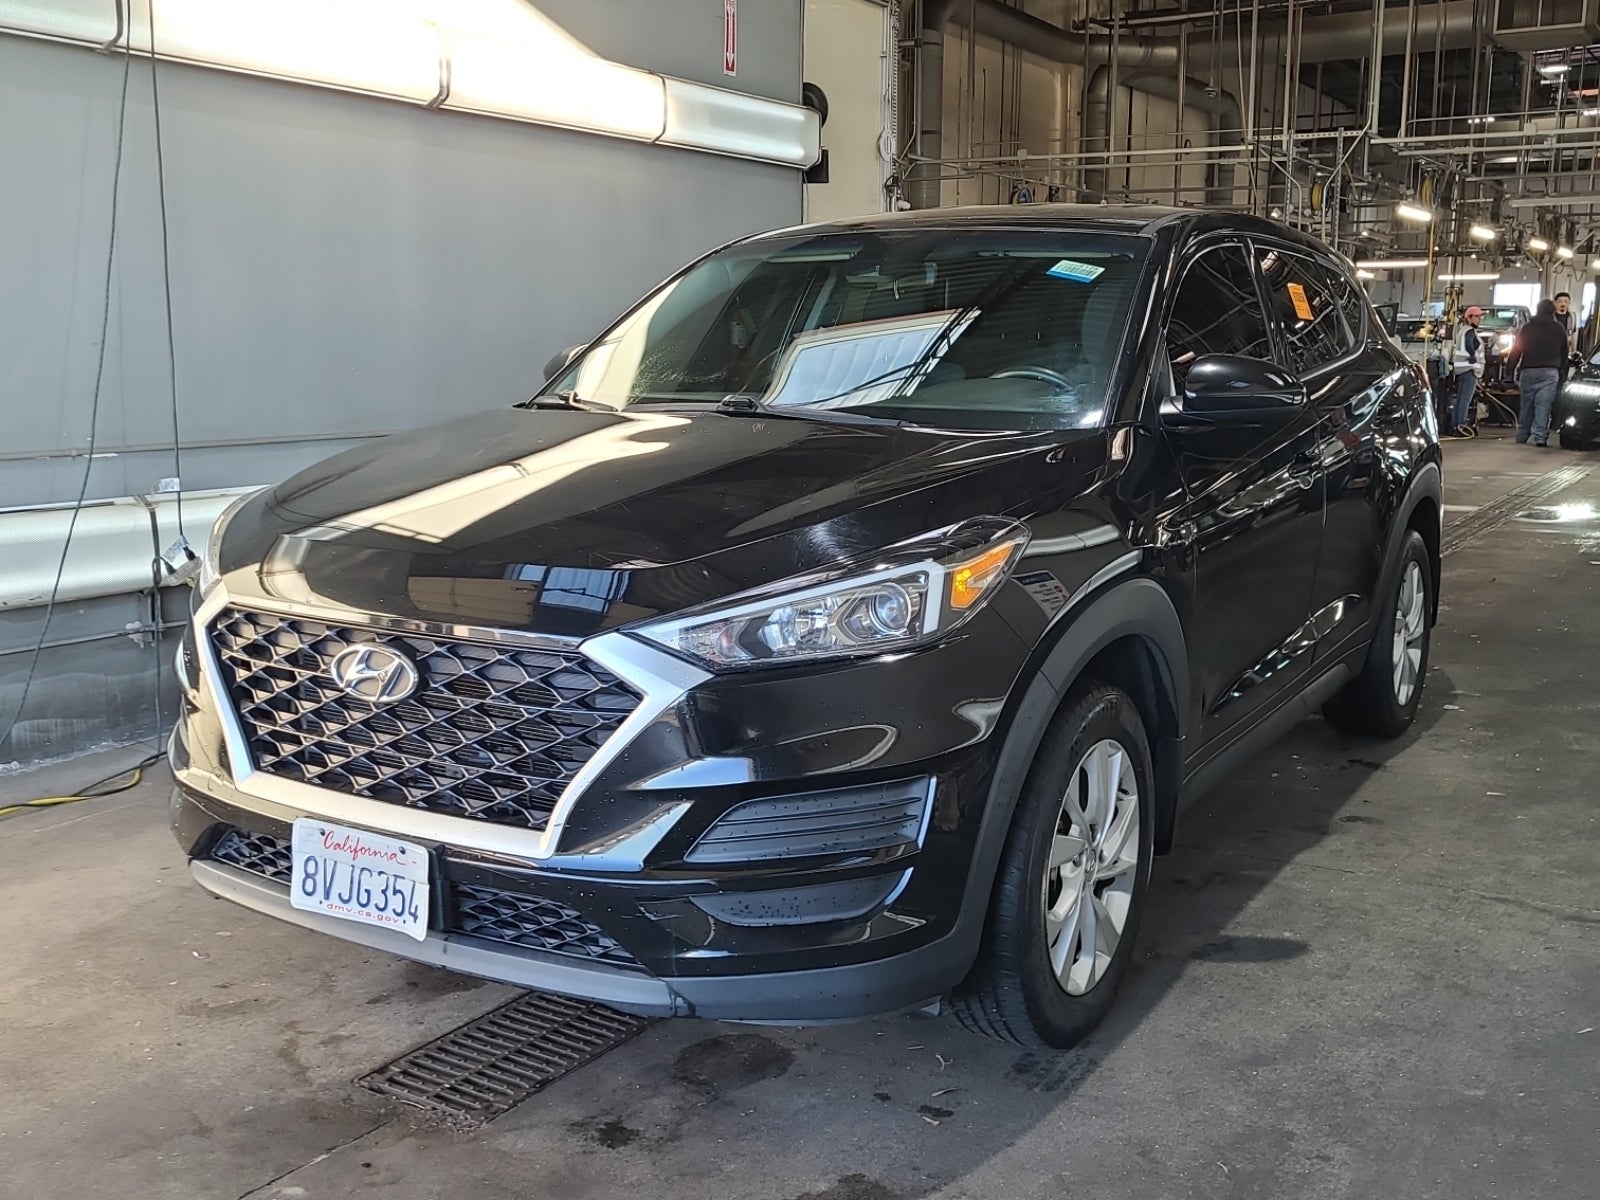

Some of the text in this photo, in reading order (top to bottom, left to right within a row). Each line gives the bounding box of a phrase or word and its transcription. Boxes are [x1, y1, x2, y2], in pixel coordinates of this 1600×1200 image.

[324, 829, 406, 865] California
[302, 855, 418, 924] 8VJG354
[326, 903, 399, 923] dmv.ca.gov
